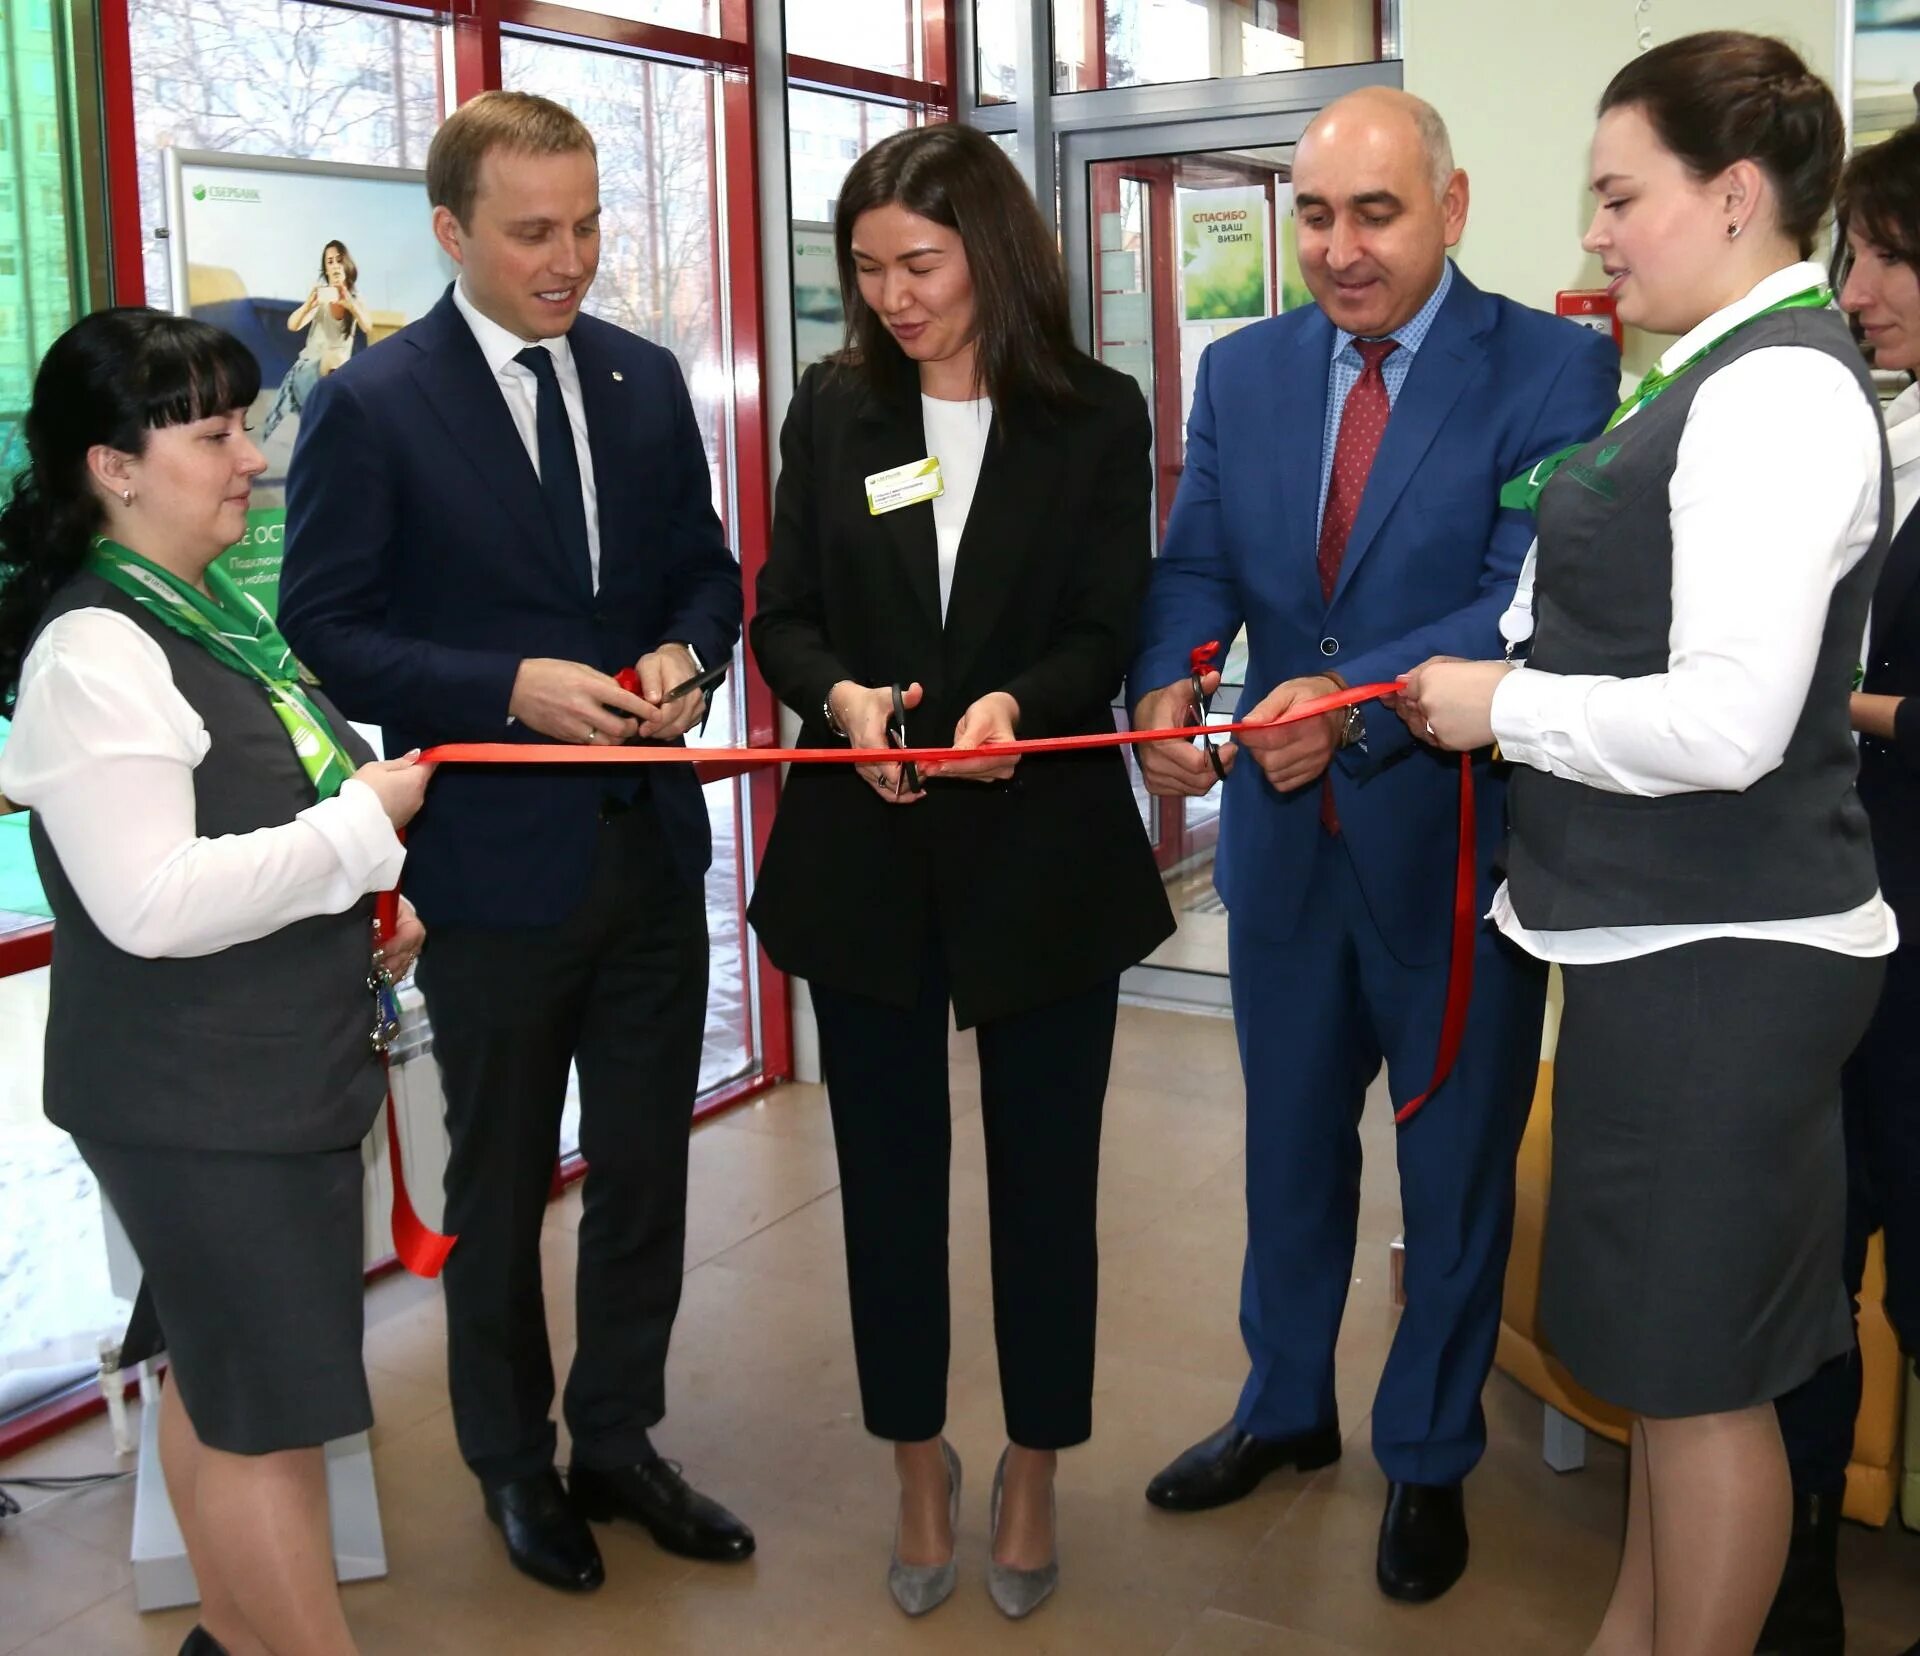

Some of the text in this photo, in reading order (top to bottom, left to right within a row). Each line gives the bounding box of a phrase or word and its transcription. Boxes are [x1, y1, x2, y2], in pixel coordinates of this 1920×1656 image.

[208, 185, 260, 200] СБЕРБАНК
[1192, 210, 1247, 224] СПАСИБО
[1207, 223, 1242, 234] ЗА ВАШ
[1217, 233, 1253, 244] ВИЗИТ!
[236, 527, 251, 546] Е
